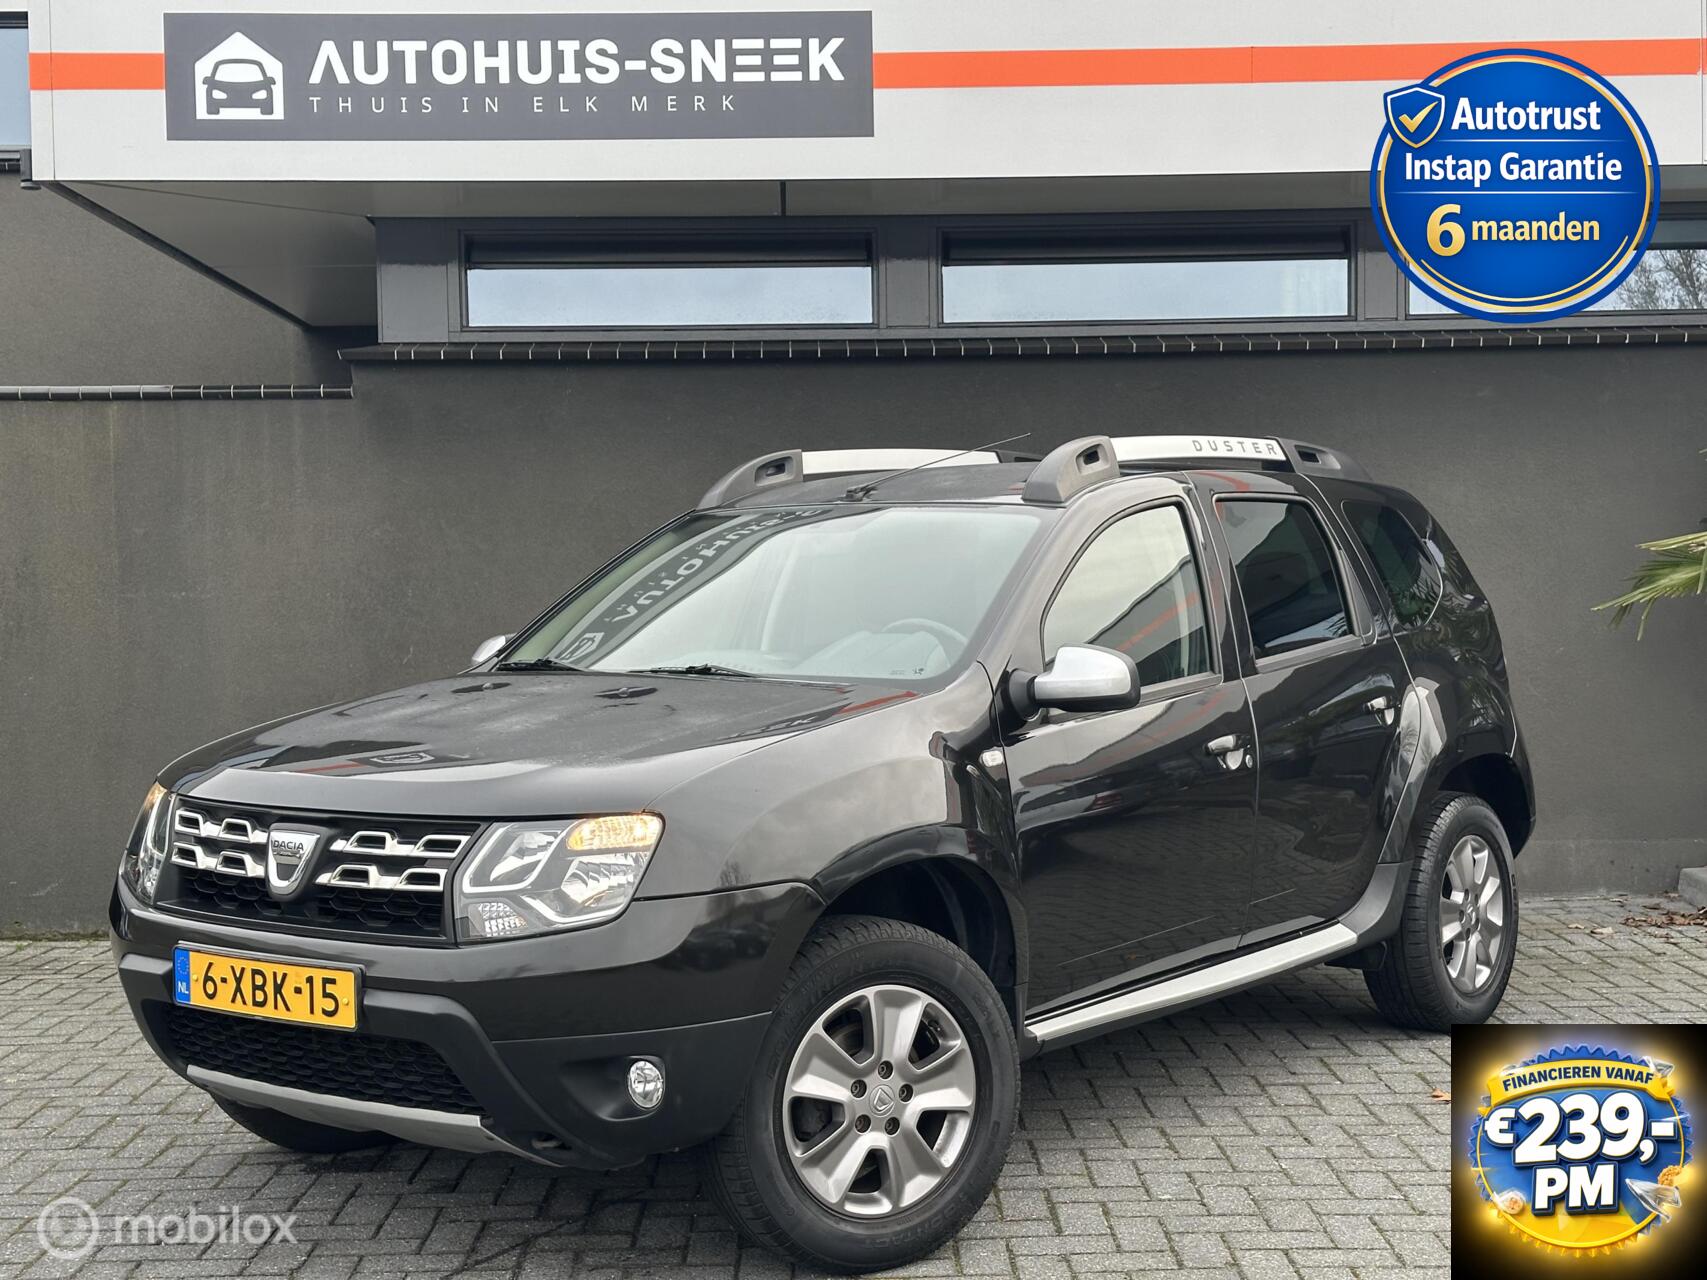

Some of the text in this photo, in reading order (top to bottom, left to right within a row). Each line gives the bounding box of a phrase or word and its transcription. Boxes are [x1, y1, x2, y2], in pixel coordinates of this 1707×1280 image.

[308, 37, 846, 86] AUTOHUIS-SNEEK
[309, 94, 735, 113] THUIS IN ELK MERK
[1191, 439, 1278, 457] DUSTER
[273, 839, 304, 852] DACIA
[177, 960, 341, 1018] NL 6-XBK-15
